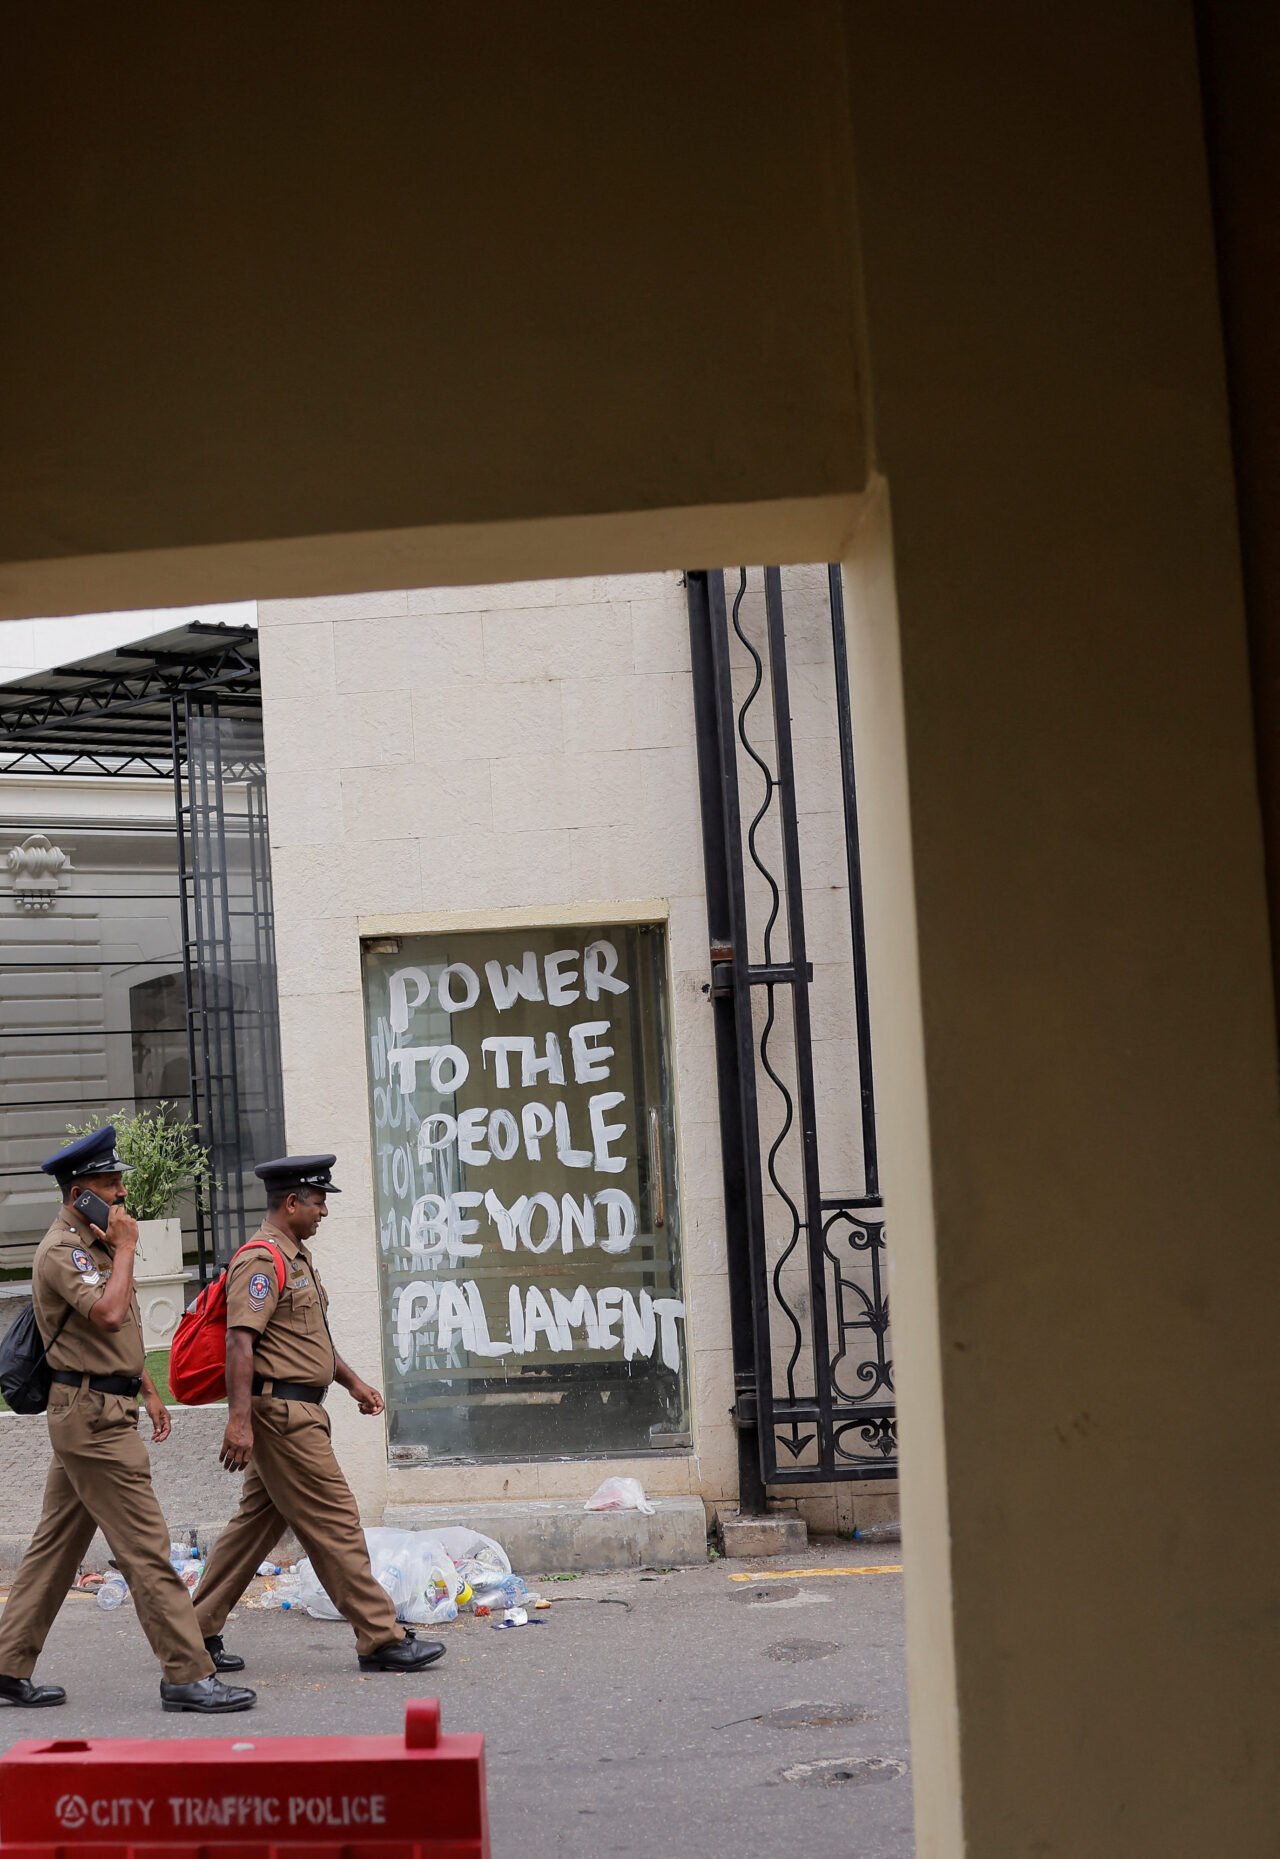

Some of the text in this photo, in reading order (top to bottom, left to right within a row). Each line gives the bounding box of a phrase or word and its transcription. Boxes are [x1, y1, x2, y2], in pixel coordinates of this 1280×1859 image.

[389, 940, 629, 1032] POWER
[388, 1045, 469, 1094] TO
[482, 1021, 614, 1087] THE
[419, 1092, 627, 1174] PEOPLE
[409, 1189, 637, 1257] BEYOND
[397, 1281, 685, 1373] PALIAMENT
[91, 1795, 386, 1826] CITY TRAFFIC POLICE
